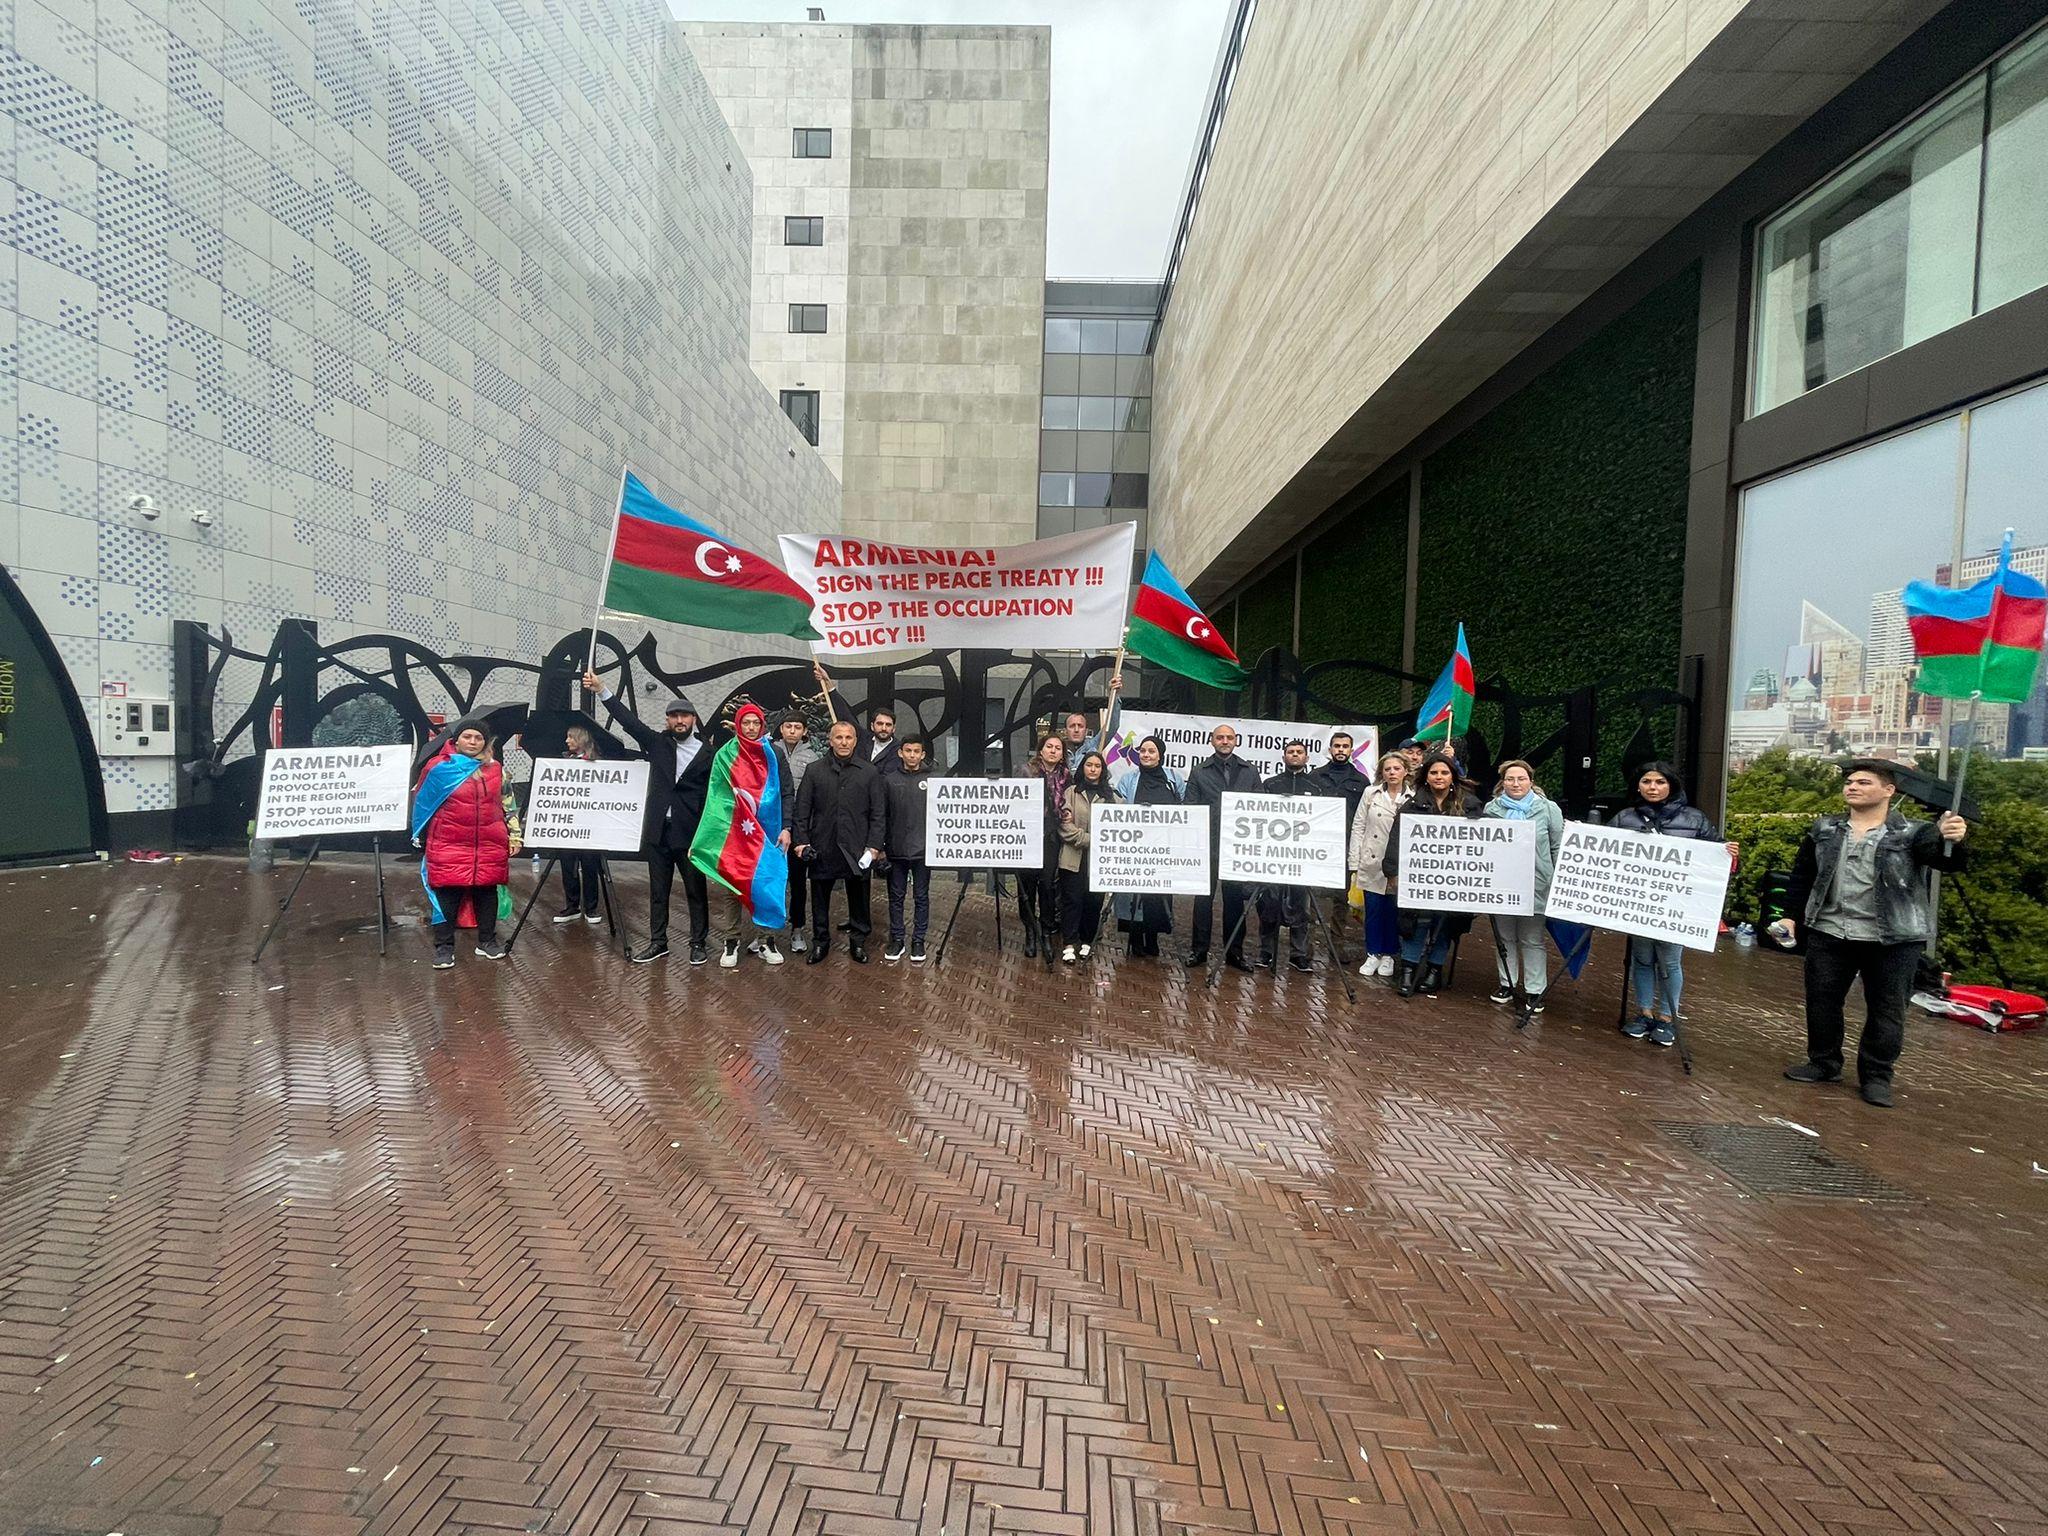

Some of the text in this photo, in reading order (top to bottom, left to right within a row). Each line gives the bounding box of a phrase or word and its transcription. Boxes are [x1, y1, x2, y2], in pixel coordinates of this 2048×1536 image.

[814, 540, 996, 567] ARMENIA!
[817, 575, 872, 594] SIGN
[878, 574, 919, 590] THE
[926, 571, 992, 590] PEACE
[998, 568, 1079, 587] TREATY
[823, 598, 1073, 623] STOP THE OCCUPATION
[827, 627, 900, 648] POLICY
[1154, 728, 1213, 745] MEMORIA
[1235, 734, 1242, 747] O
[272, 754, 381, 770] ARMENIA!
[1166, 754, 1185, 768] IED
[292, 772, 318, 780] NOT
[540, 768, 629, 784] ARMENIA!
[269, 782, 356, 792] PROVOCATEUR
[538, 786, 590, 797] RESTORE
[937, 785, 1029, 799] ARMENIA!
[268, 792, 367, 803] IN THE REGION!!!
[266, 803, 398, 817] STOP YOUR MILITARY
[536, 800, 637, 811] COMMUNICATIONS
[937, 804, 1010, 814] WITHDRAW
[1234, 800, 1312, 814] ARMENIA!
[264, 816, 371, 828] PROVOCATIONS!!!
[534, 813, 573, 824] IN THE
[936, 819, 1026, 829] YOUR ILLEGAL
[1100, 810, 1188, 824] ARMENIA!
[532, 828, 590, 839] REGION!!!
[1100, 829, 1143, 842] STOP
[1234, 817, 1310, 841] STOP
[1410, 824, 1513, 842] ARMENIA!
[936, 834, 1026, 844] TROOPS FROM
[936, 849, 1022, 860] KARABAKH!!!
[1120, 846, 1171, 854] BLOCKADE
[1233, 844, 1327, 860] THE MINING
[1410, 843, 1484, 856] ACCEPT EU
[1565, 833, 1692, 866] ARMENIA!
[1134, 857, 1201, 866] NAKHCHIVAN
[1233, 860, 1301, 876] POLICY!!!
[1409, 858, 1494, 872] MEDIATION!
[1561, 852, 1688, 882] DO NOT CONDUCT
[1099, 867, 1156, 876] EXCLAVE OF
[1099, 878, 1161, 887] AZERBAIJAN
[1408, 874, 1491, 887] RECOGNIZE
[1559, 864, 1693, 895] POLICIES THAT SERVE
[1557, 875, 1668, 903] THE INTERESTS OF
[1408, 889, 1434, 899] THE
[1438, 891, 1503, 904] BORDERS
[1554, 887, 1684, 919] THIRD COUNTRIES IN
[1551, 898, 1709, 938] THE SOUTH CAUCASUS!!!
